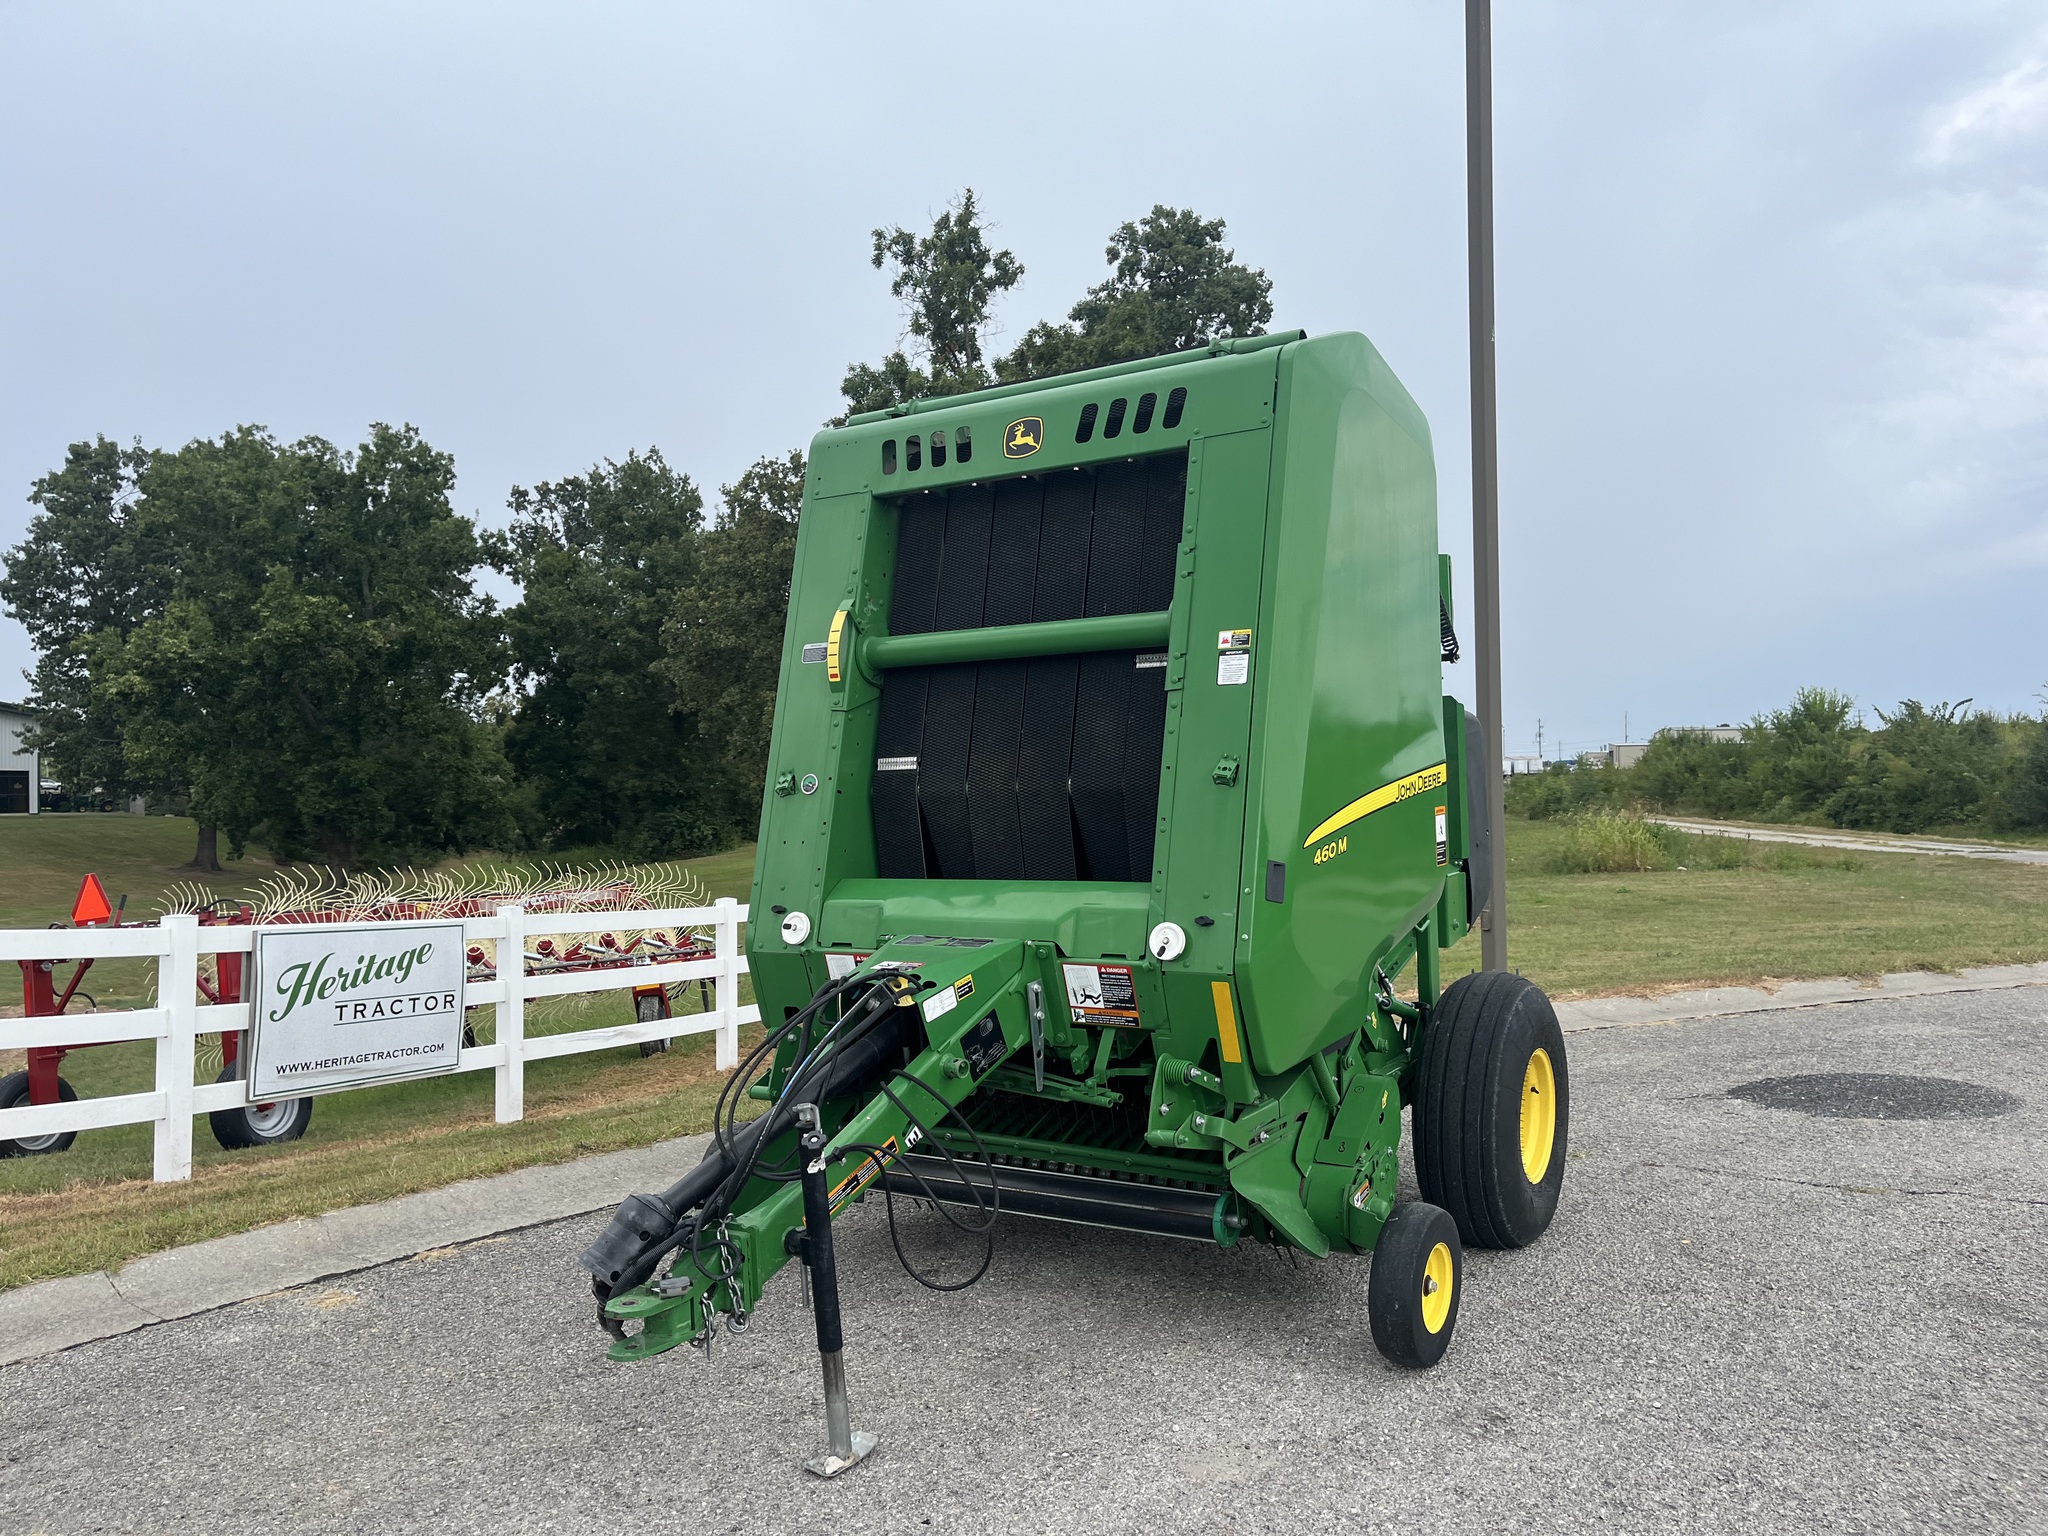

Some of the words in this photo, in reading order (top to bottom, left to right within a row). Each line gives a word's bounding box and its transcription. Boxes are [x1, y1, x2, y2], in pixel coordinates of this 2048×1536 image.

[1395, 782, 1417, 801] JOHN
[1417, 771, 1442, 792] DEERE
[269, 942, 435, 1022] Heritage
[334, 993, 456, 1022] TRACTOR
[276, 1042, 445, 1075] WWW.HERITAGETRACTOR.COM
